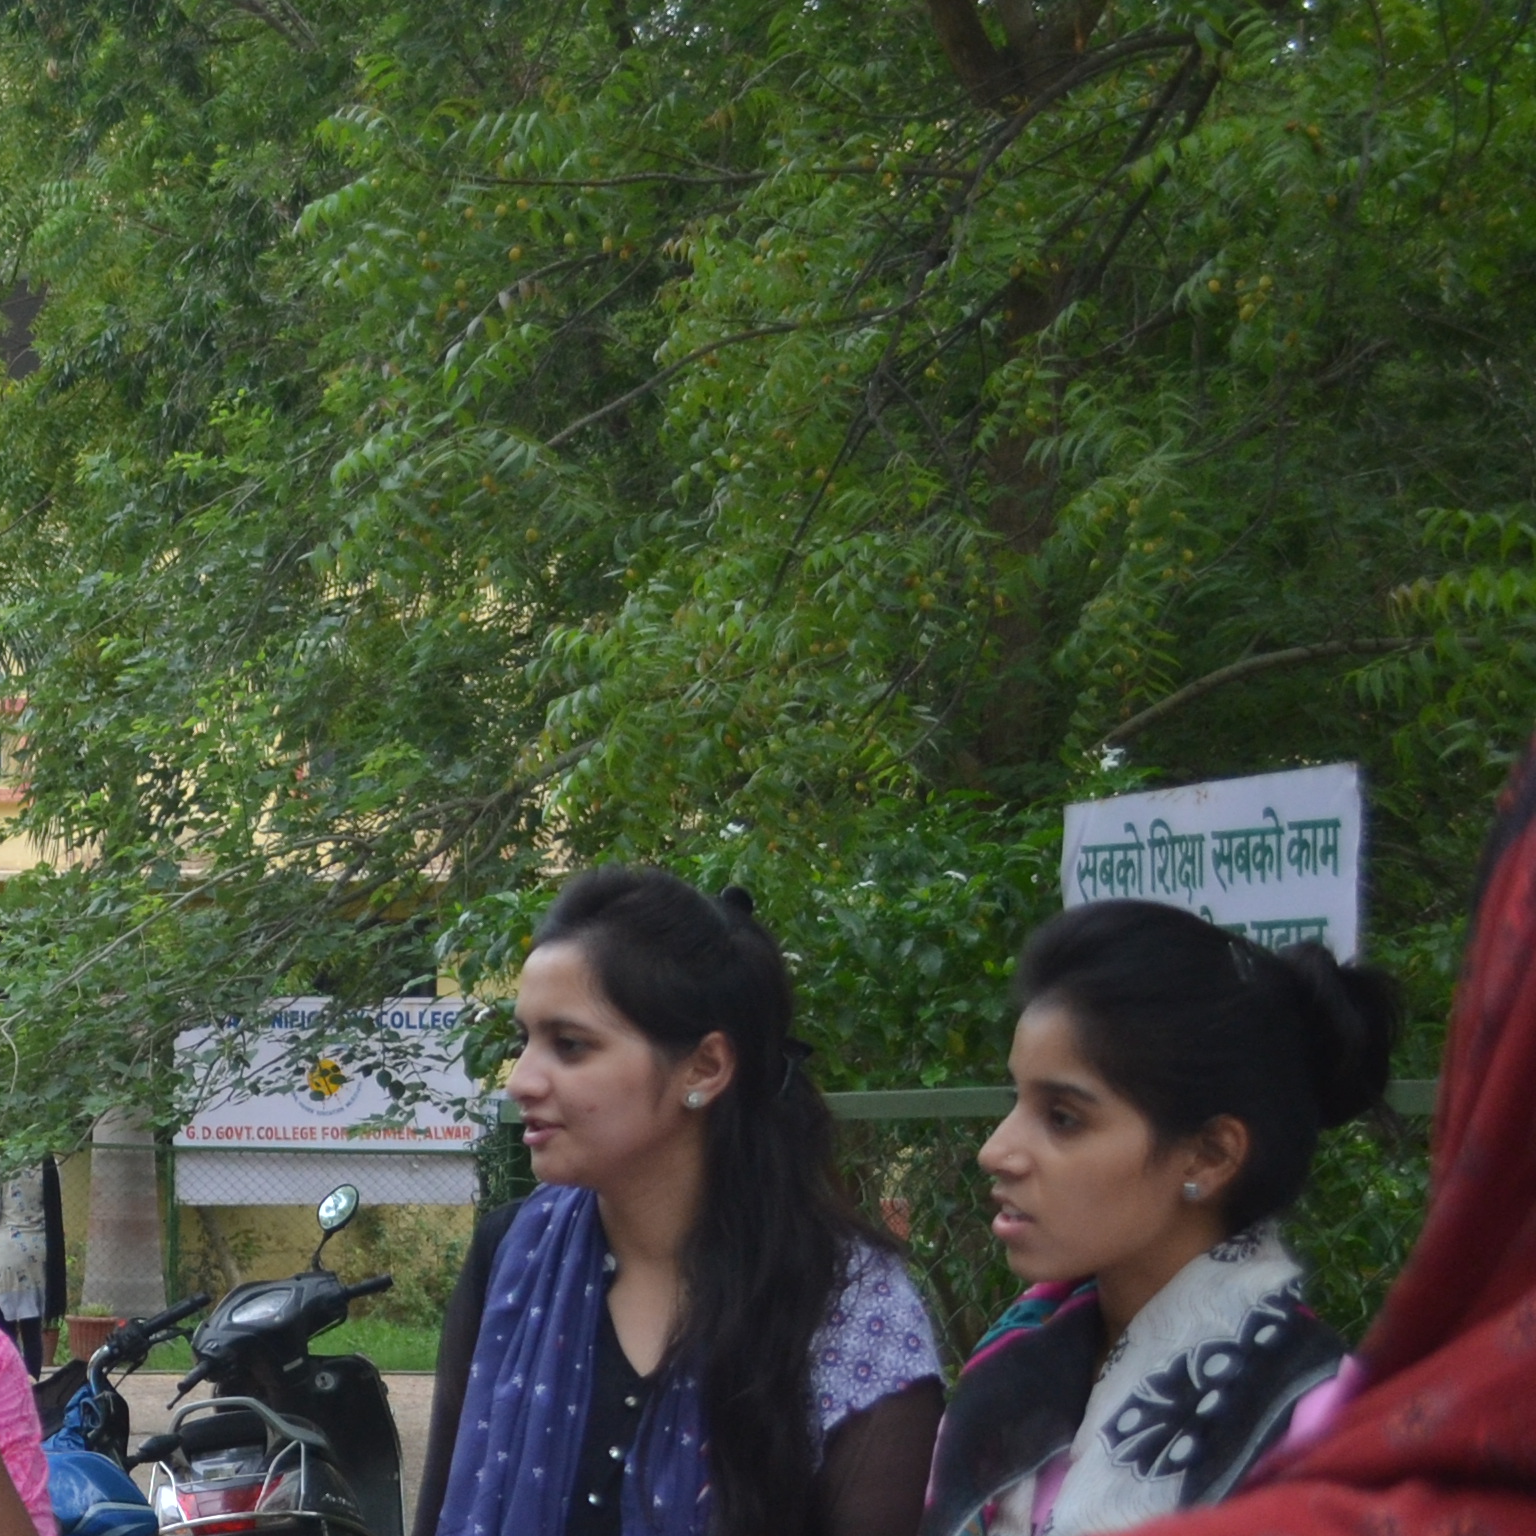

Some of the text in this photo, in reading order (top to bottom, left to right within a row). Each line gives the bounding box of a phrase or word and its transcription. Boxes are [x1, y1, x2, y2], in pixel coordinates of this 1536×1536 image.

[1077, 806, 1342, 905] सबको शिक्षा सबको काम
[375, 1009, 461, 1030] COLLEG
[256, 1126, 318, 1141] COLLEGE
[423, 1125, 472, 1141] ALWAR
